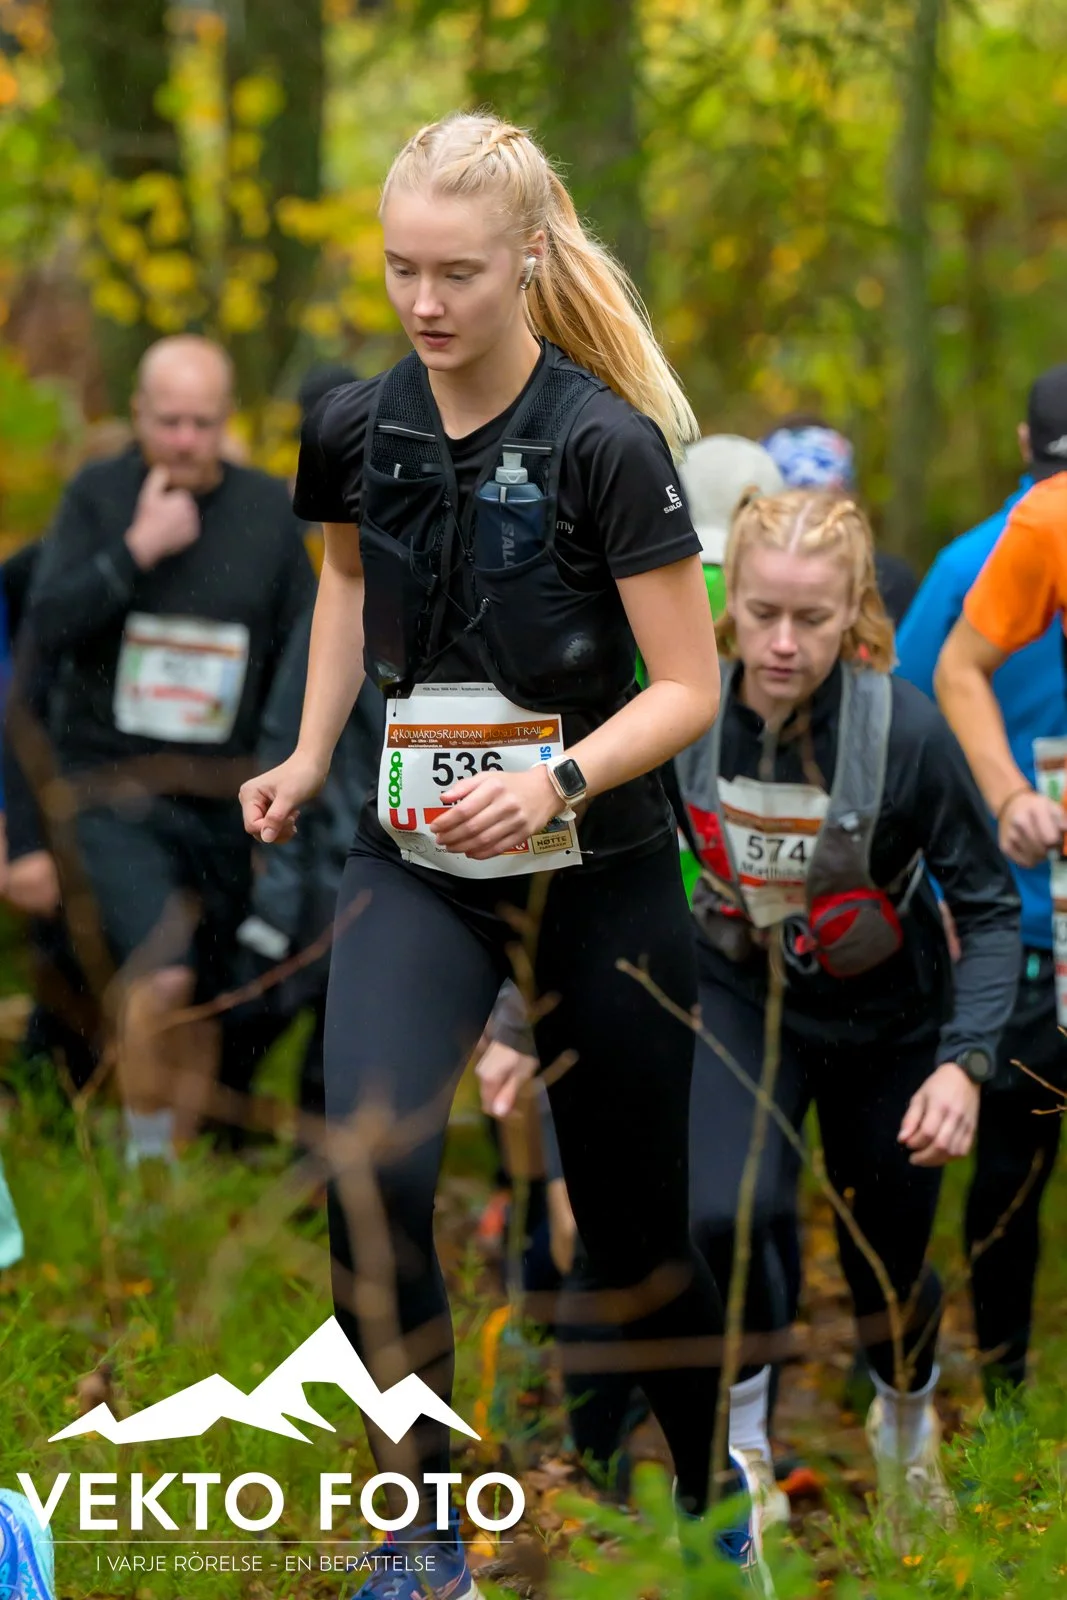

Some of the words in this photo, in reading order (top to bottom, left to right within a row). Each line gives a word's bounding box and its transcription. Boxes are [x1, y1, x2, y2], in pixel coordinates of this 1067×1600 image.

[516, 726, 543, 737] TRAIL
[388, 751, 403, 808] coop
[432, 751, 504, 786] 536
[747, 836, 807, 864] 574
